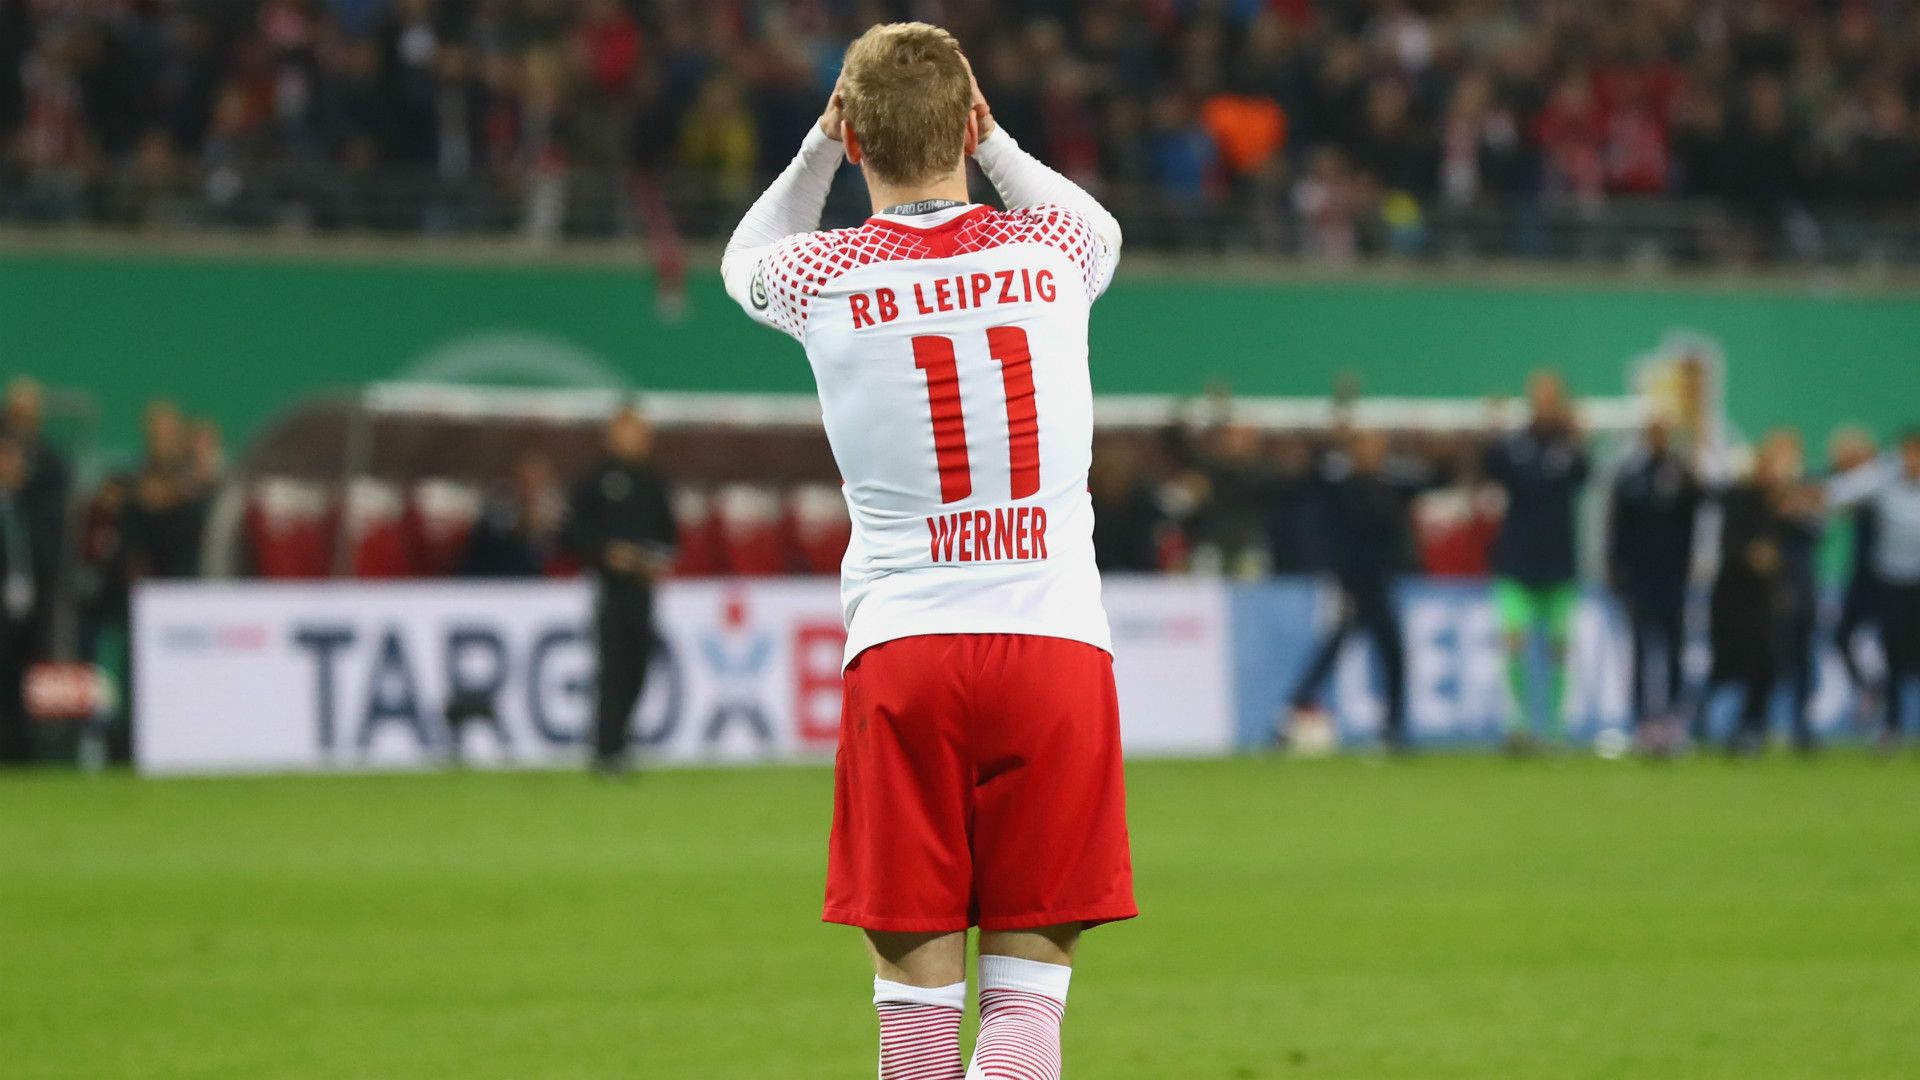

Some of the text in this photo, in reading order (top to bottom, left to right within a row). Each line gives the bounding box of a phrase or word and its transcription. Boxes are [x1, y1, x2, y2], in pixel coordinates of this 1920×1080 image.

[894, 203, 916, 215] PRO
[849, 268, 1056, 329] RB LEIPZIG
[911, 326, 1040, 504] 11
[927, 506, 1048, 562] WERNER
